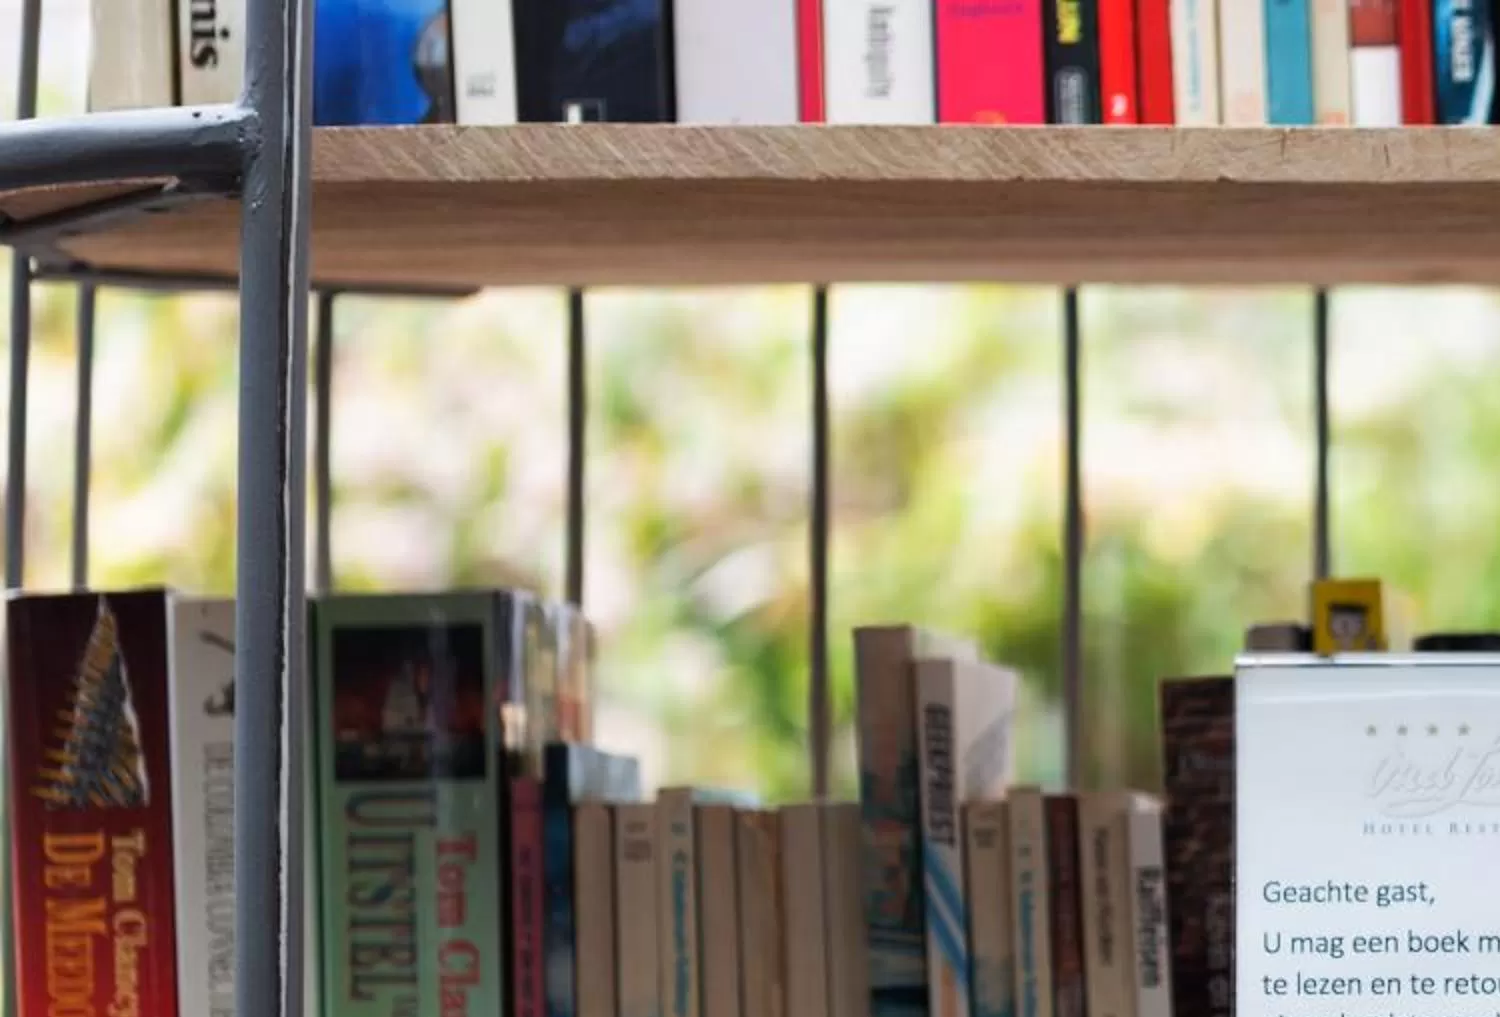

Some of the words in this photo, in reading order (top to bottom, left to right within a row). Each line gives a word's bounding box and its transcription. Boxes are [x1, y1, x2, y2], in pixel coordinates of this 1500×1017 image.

[111, 827, 148, 902] Tom
[436, 831, 480, 928] Tom
[1262, 879, 1370, 904] Geachte
[1375, 881, 1436, 908] gast,
[1263, 931, 1282, 954] U
[1290, 935, 1345, 959] mag
[1351, 935, 1399, 954] een
[1407, 929, 1471, 954] boek
[1262, 974, 1288, 996] te
[1296, 970, 1363, 996] lezen
[1370, 976, 1402, 996] en
[1409, 974, 1436, 996] te
